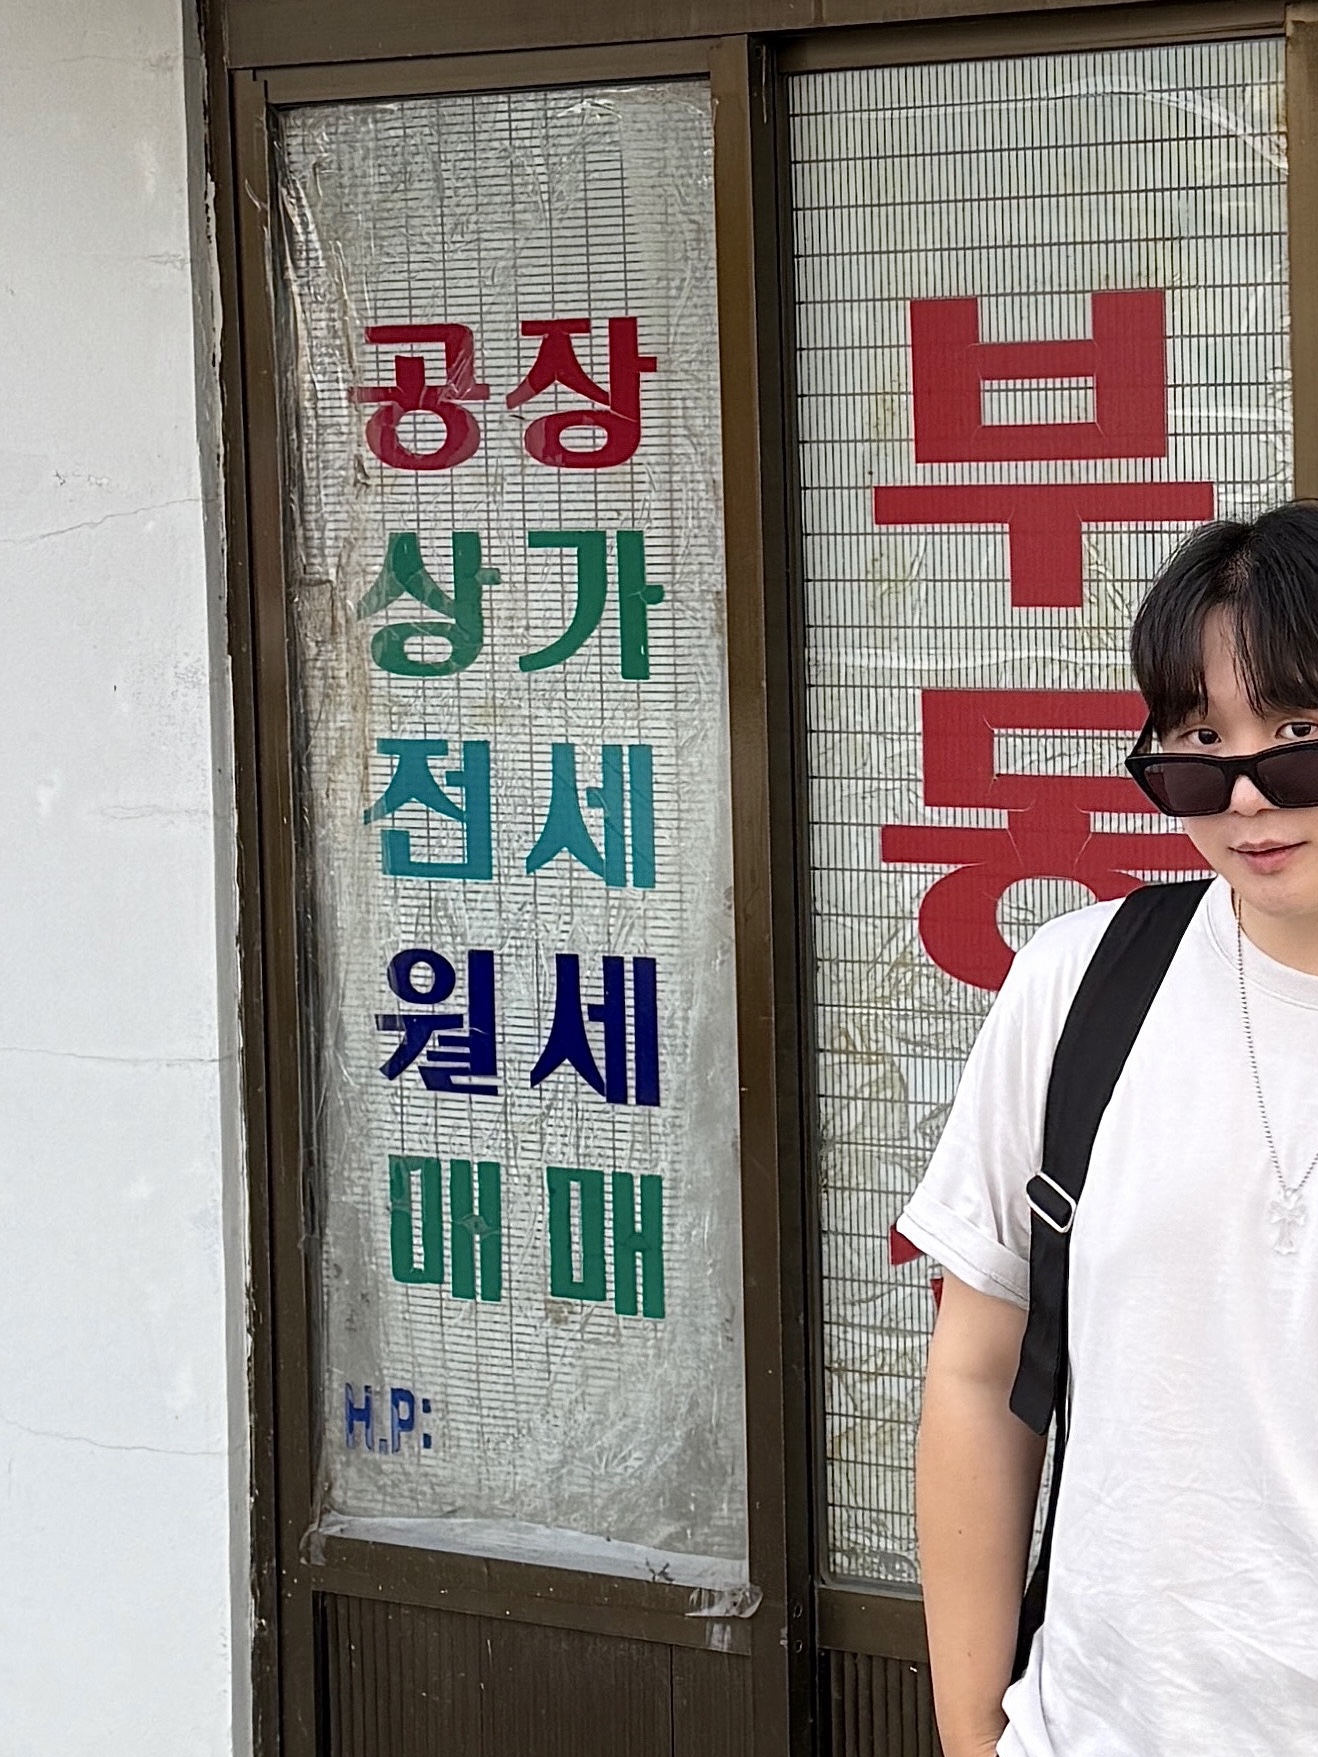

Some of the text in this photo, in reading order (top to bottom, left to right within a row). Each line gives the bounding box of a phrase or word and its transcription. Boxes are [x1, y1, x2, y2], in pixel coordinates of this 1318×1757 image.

[346, 314, 658, 471] 공장
[355, 528, 667, 682] 상가
[362, 737, 656, 890] 전세
[374, 946, 662, 1108] 월세
[388, 1153, 666, 1320] 매매
